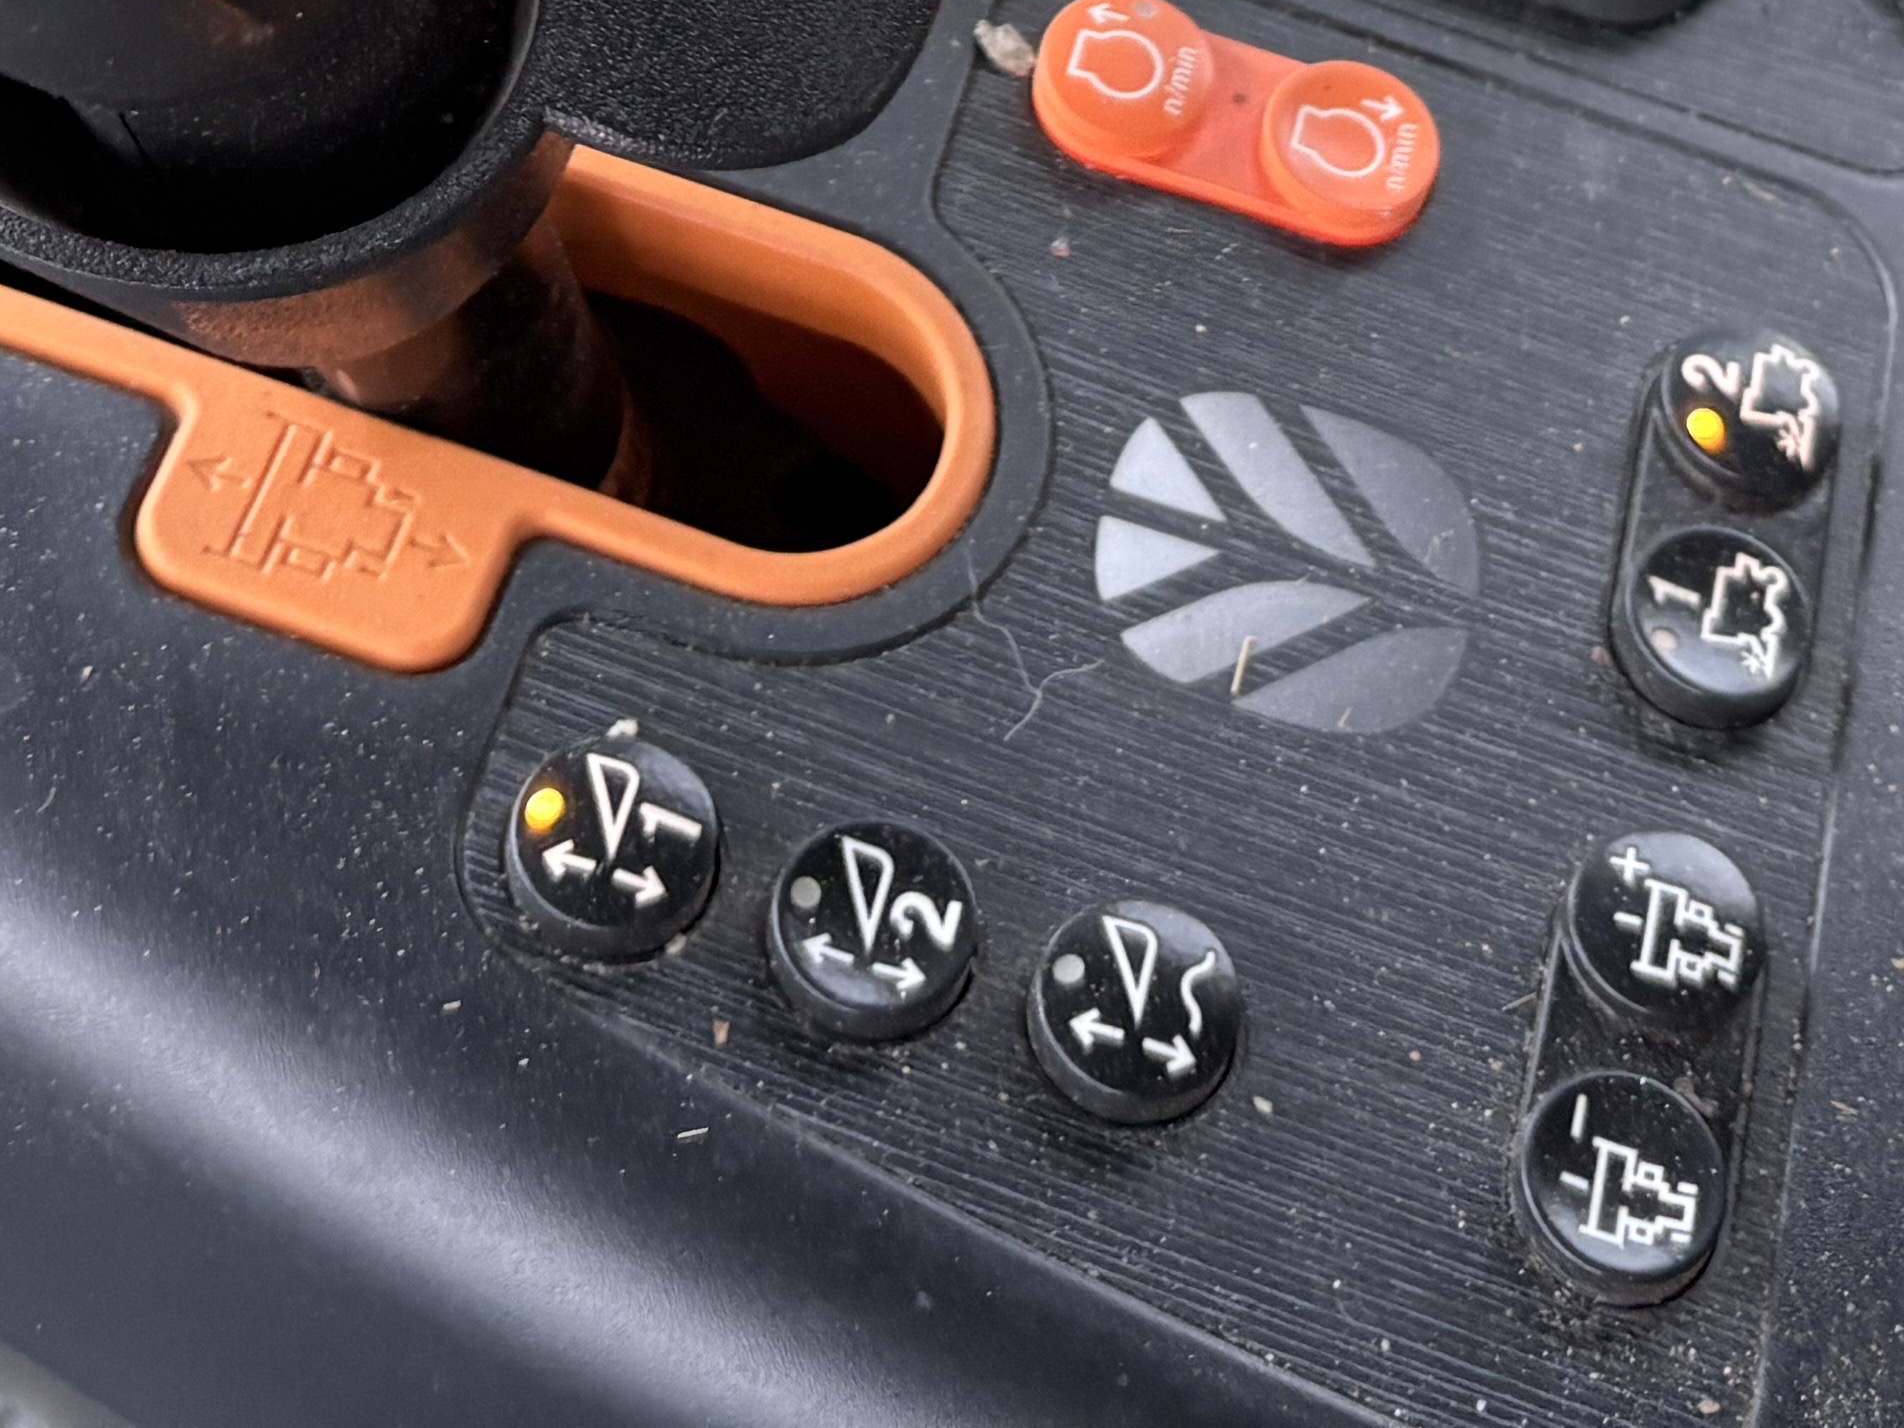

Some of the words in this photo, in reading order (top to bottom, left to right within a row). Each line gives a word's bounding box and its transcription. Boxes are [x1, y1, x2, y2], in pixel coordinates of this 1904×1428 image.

[1681, 352, 1742, 404] 2
[1647, 575, 1702, 606] 1
[640, 801, 703, 843] 1
[889, 890, 964, 951] 2
